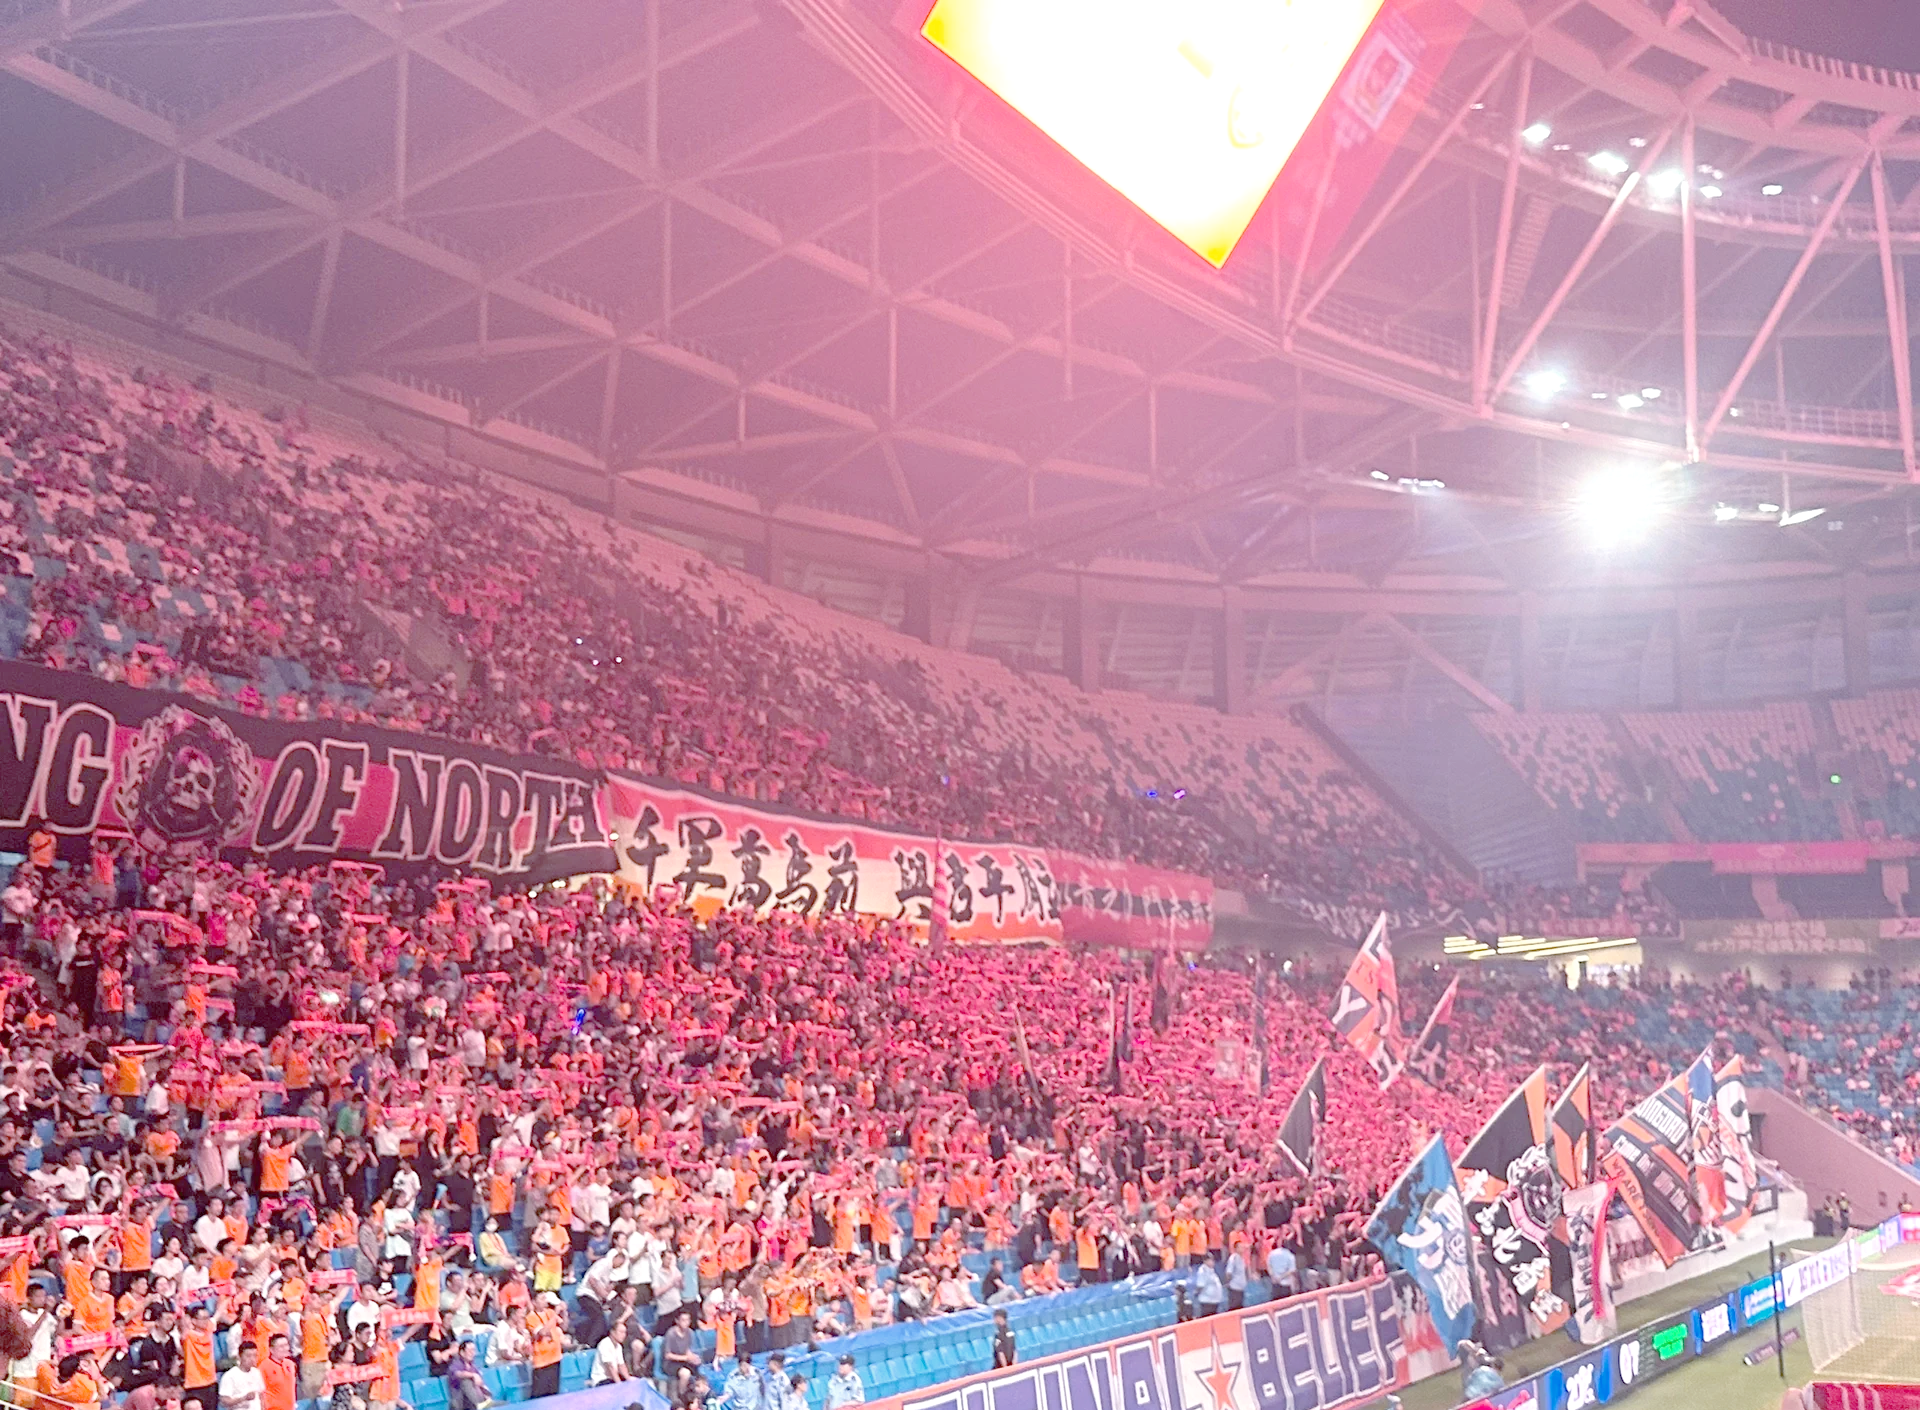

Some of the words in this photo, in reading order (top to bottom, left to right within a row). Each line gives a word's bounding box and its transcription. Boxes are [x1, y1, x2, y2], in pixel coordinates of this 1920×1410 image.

[252, 740, 370, 853] OF
[371, 746, 611, 875] NORTH
[1241, 1276, 1404, 1410] BELIEF
